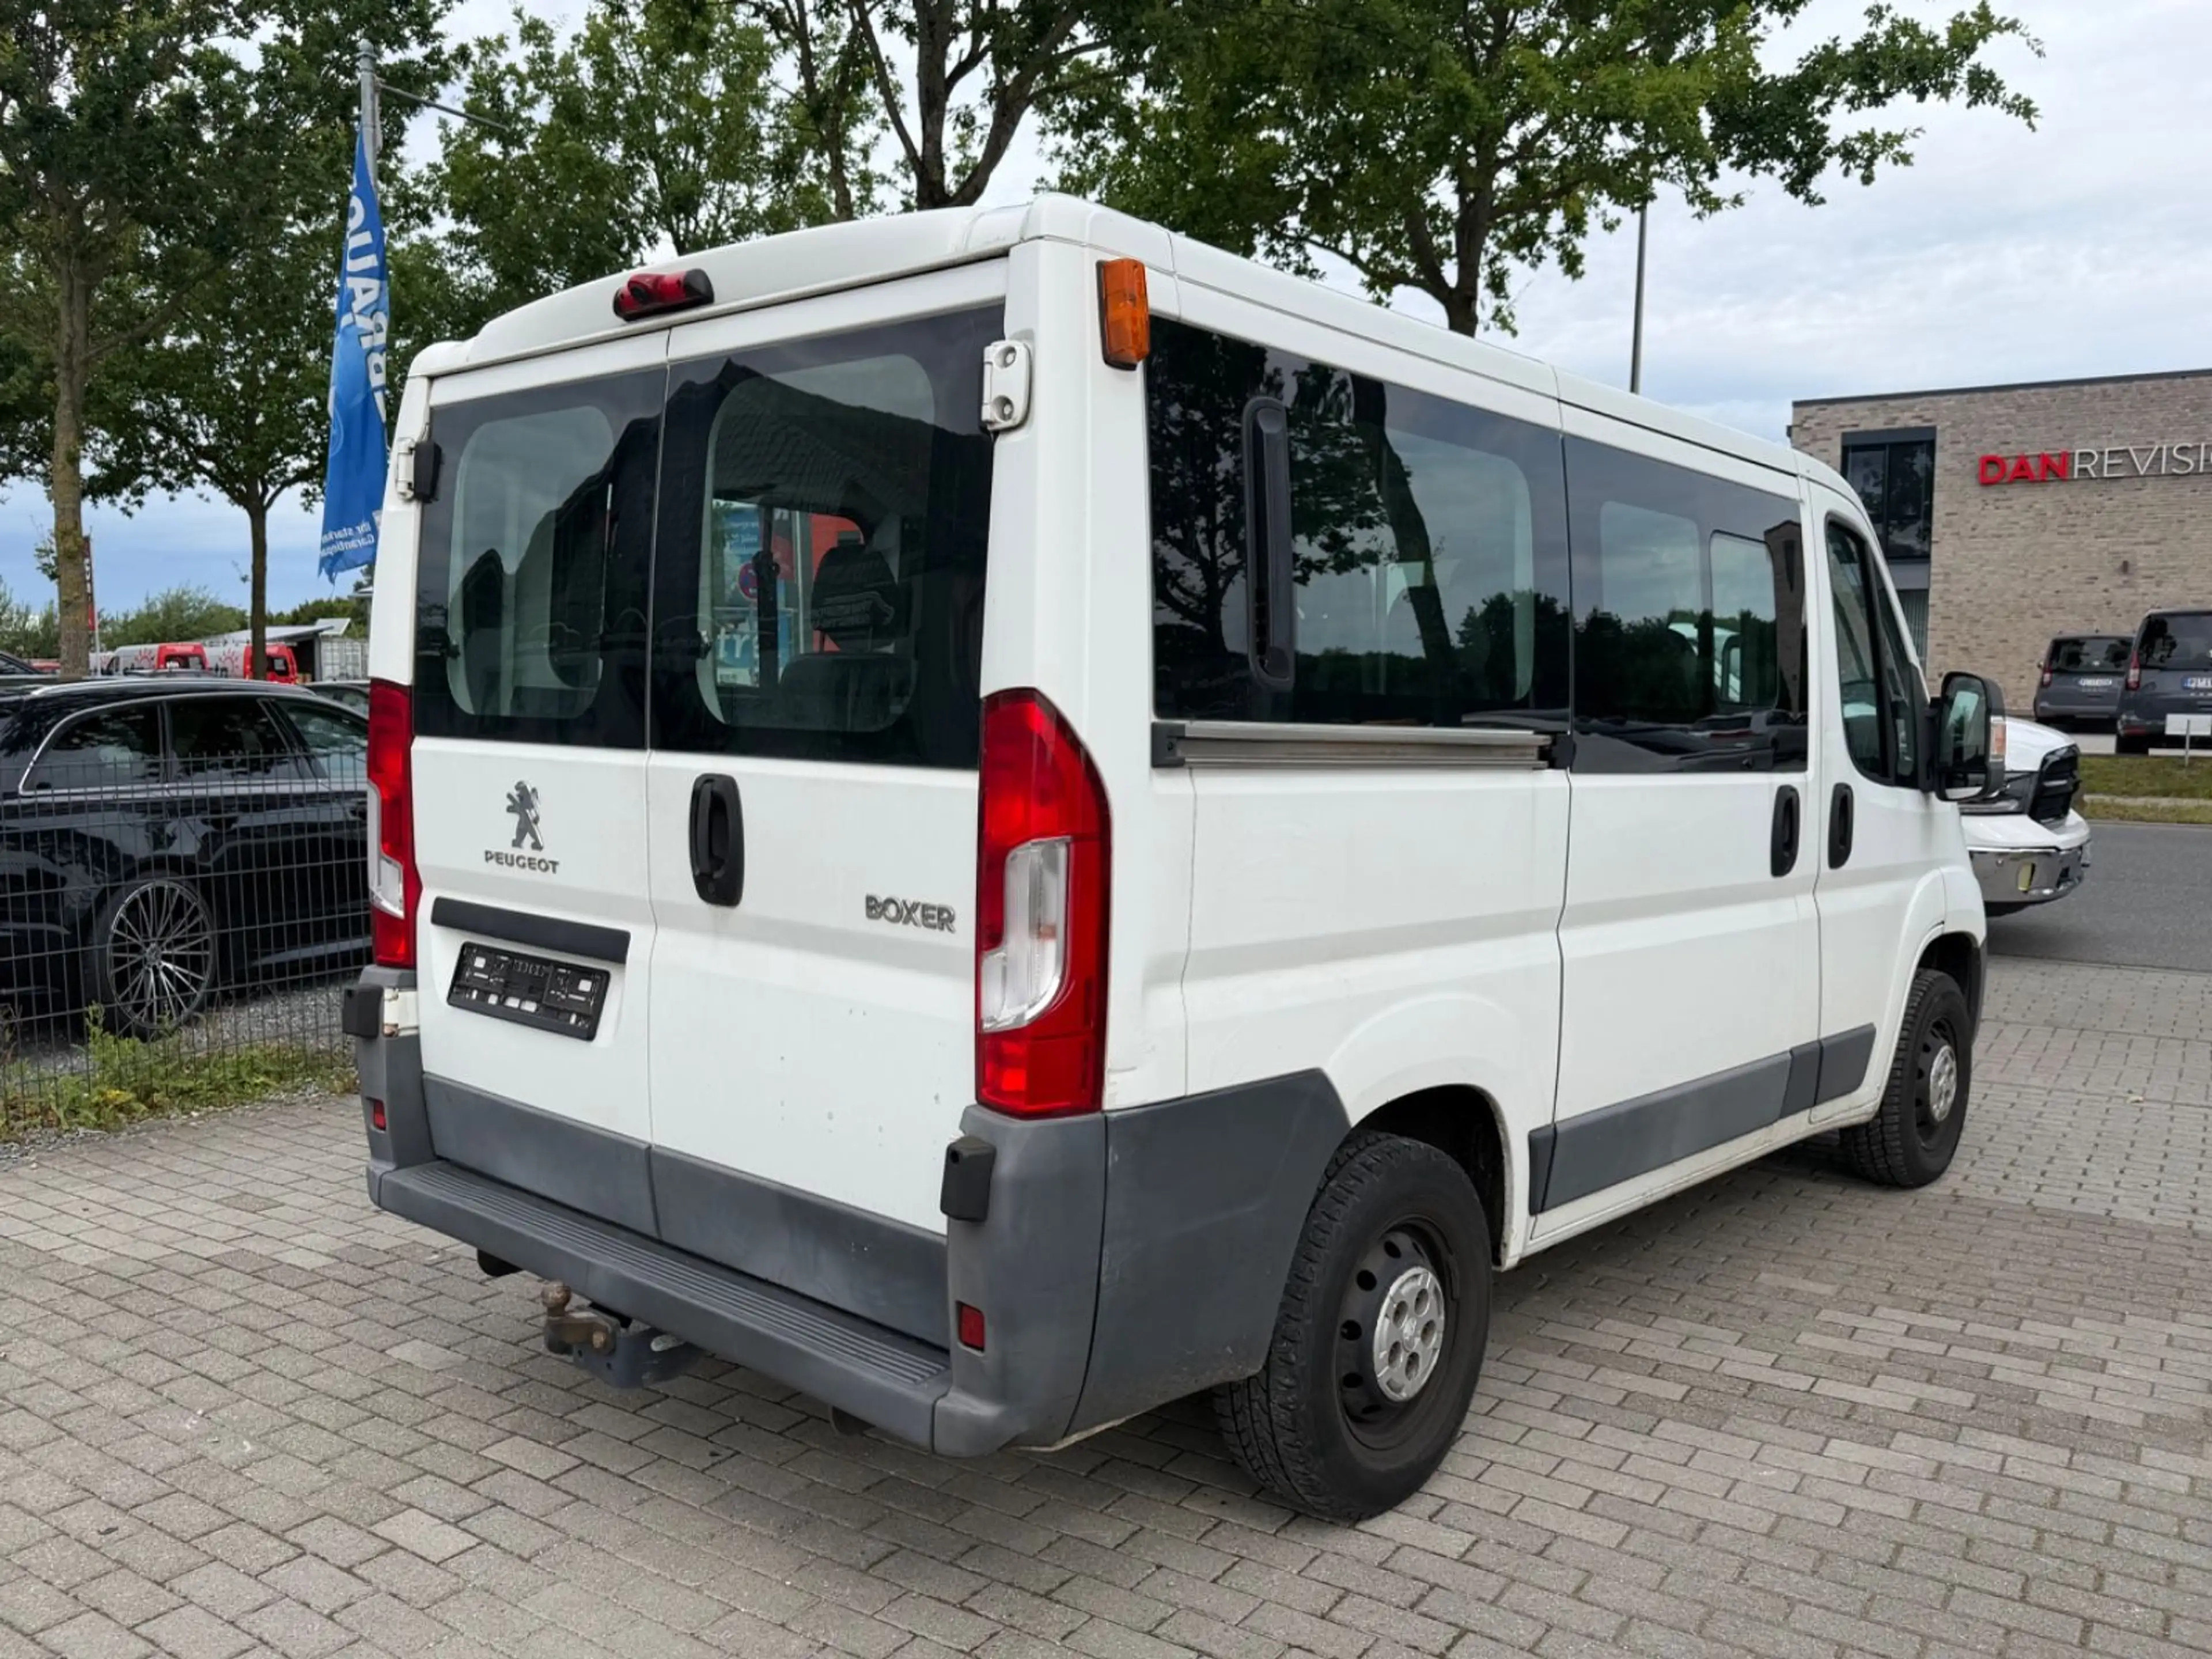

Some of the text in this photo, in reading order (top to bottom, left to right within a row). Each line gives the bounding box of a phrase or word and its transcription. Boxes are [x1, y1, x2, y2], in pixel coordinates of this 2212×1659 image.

[1978, 442, 2212, 486] DANREVISI
[484, 850, 559, 874] PEUGEOT
[865, 894, 956, 934] BOXER
